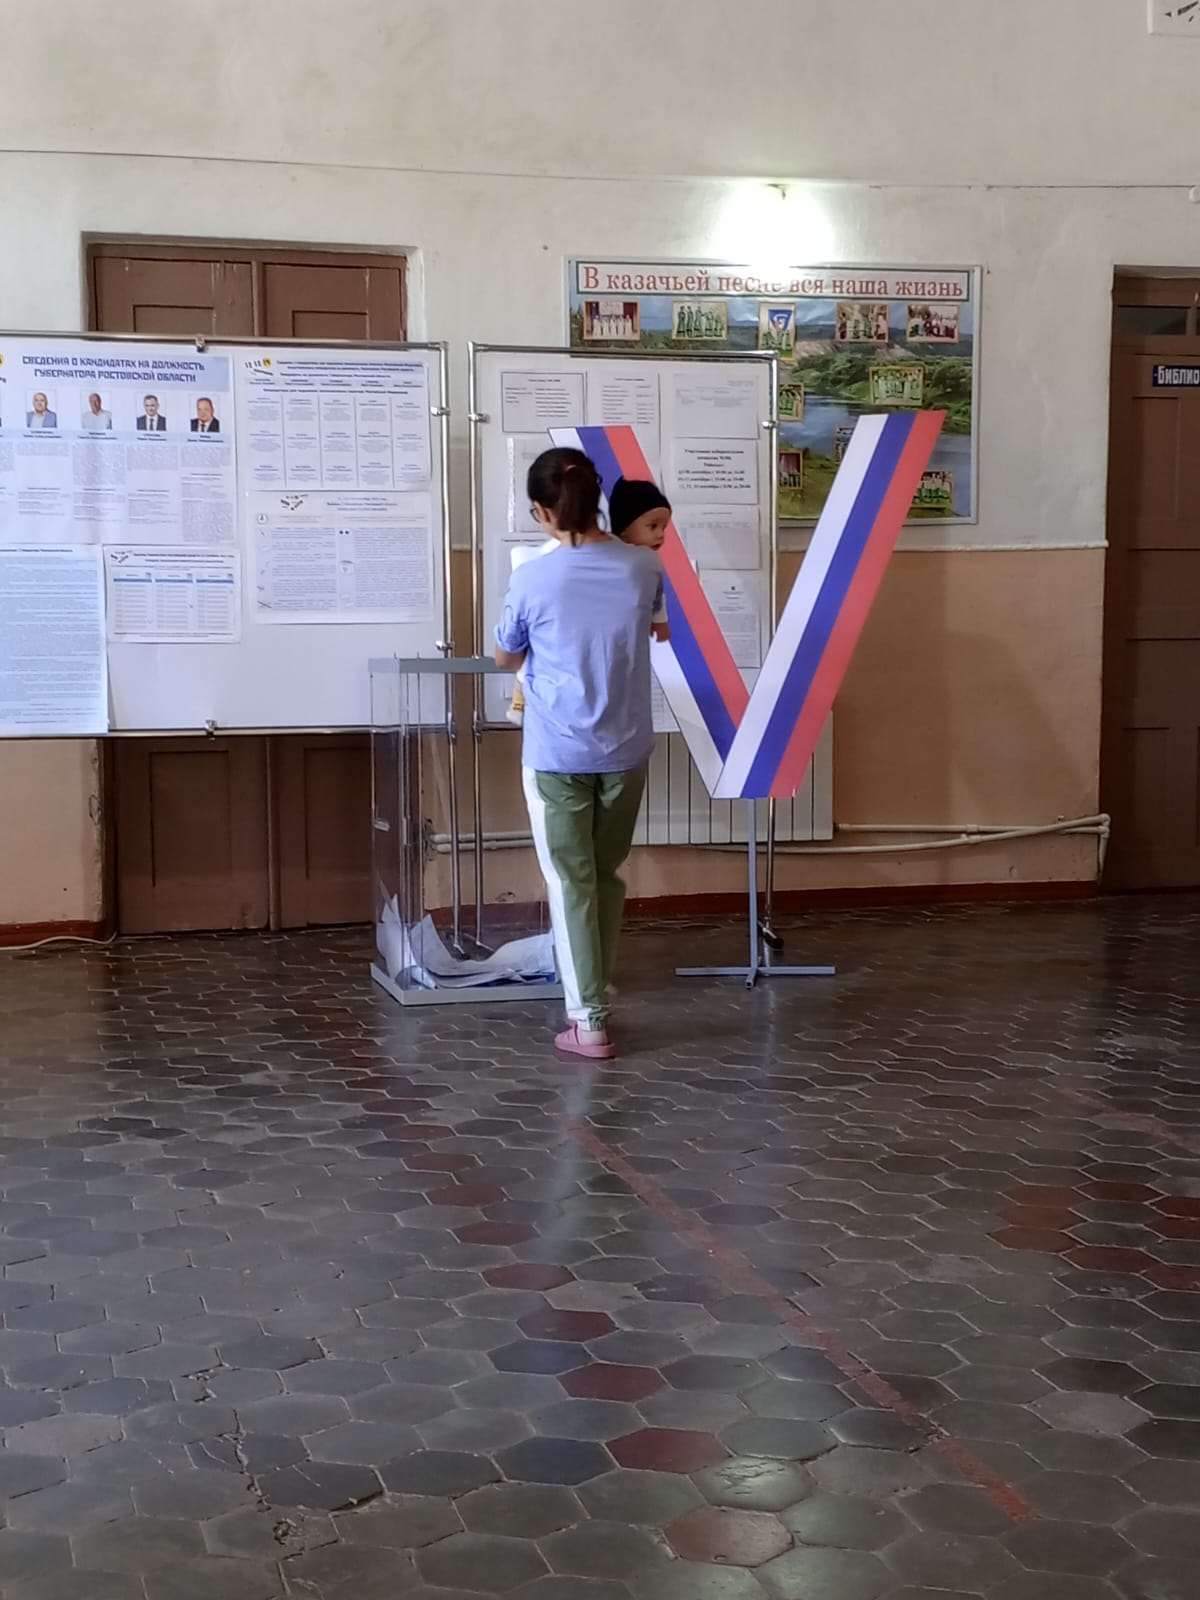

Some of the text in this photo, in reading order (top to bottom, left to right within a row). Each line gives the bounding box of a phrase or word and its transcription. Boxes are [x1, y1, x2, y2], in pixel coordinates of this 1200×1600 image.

[583, 266, 600, 289] В
[606, 270, 710, 291] казачьей
[789, 279, 824, 294] вся
[832, 279, 888, 296] наша
[895, 280, 963, 297] жизнь
[22, 355, 70, 366] СВЕДЕНИЯ
[79, 357, 137, 368] КАНДИДАТАХ
[138, 360, 150, 368] НА
[151, 360, 205, 371] ДОЛЖНОСТЬ
[34, 368, 197, 382] ГУБЕРНАТОРА РОСТОВСКОЙ ОБЛАСТИ
